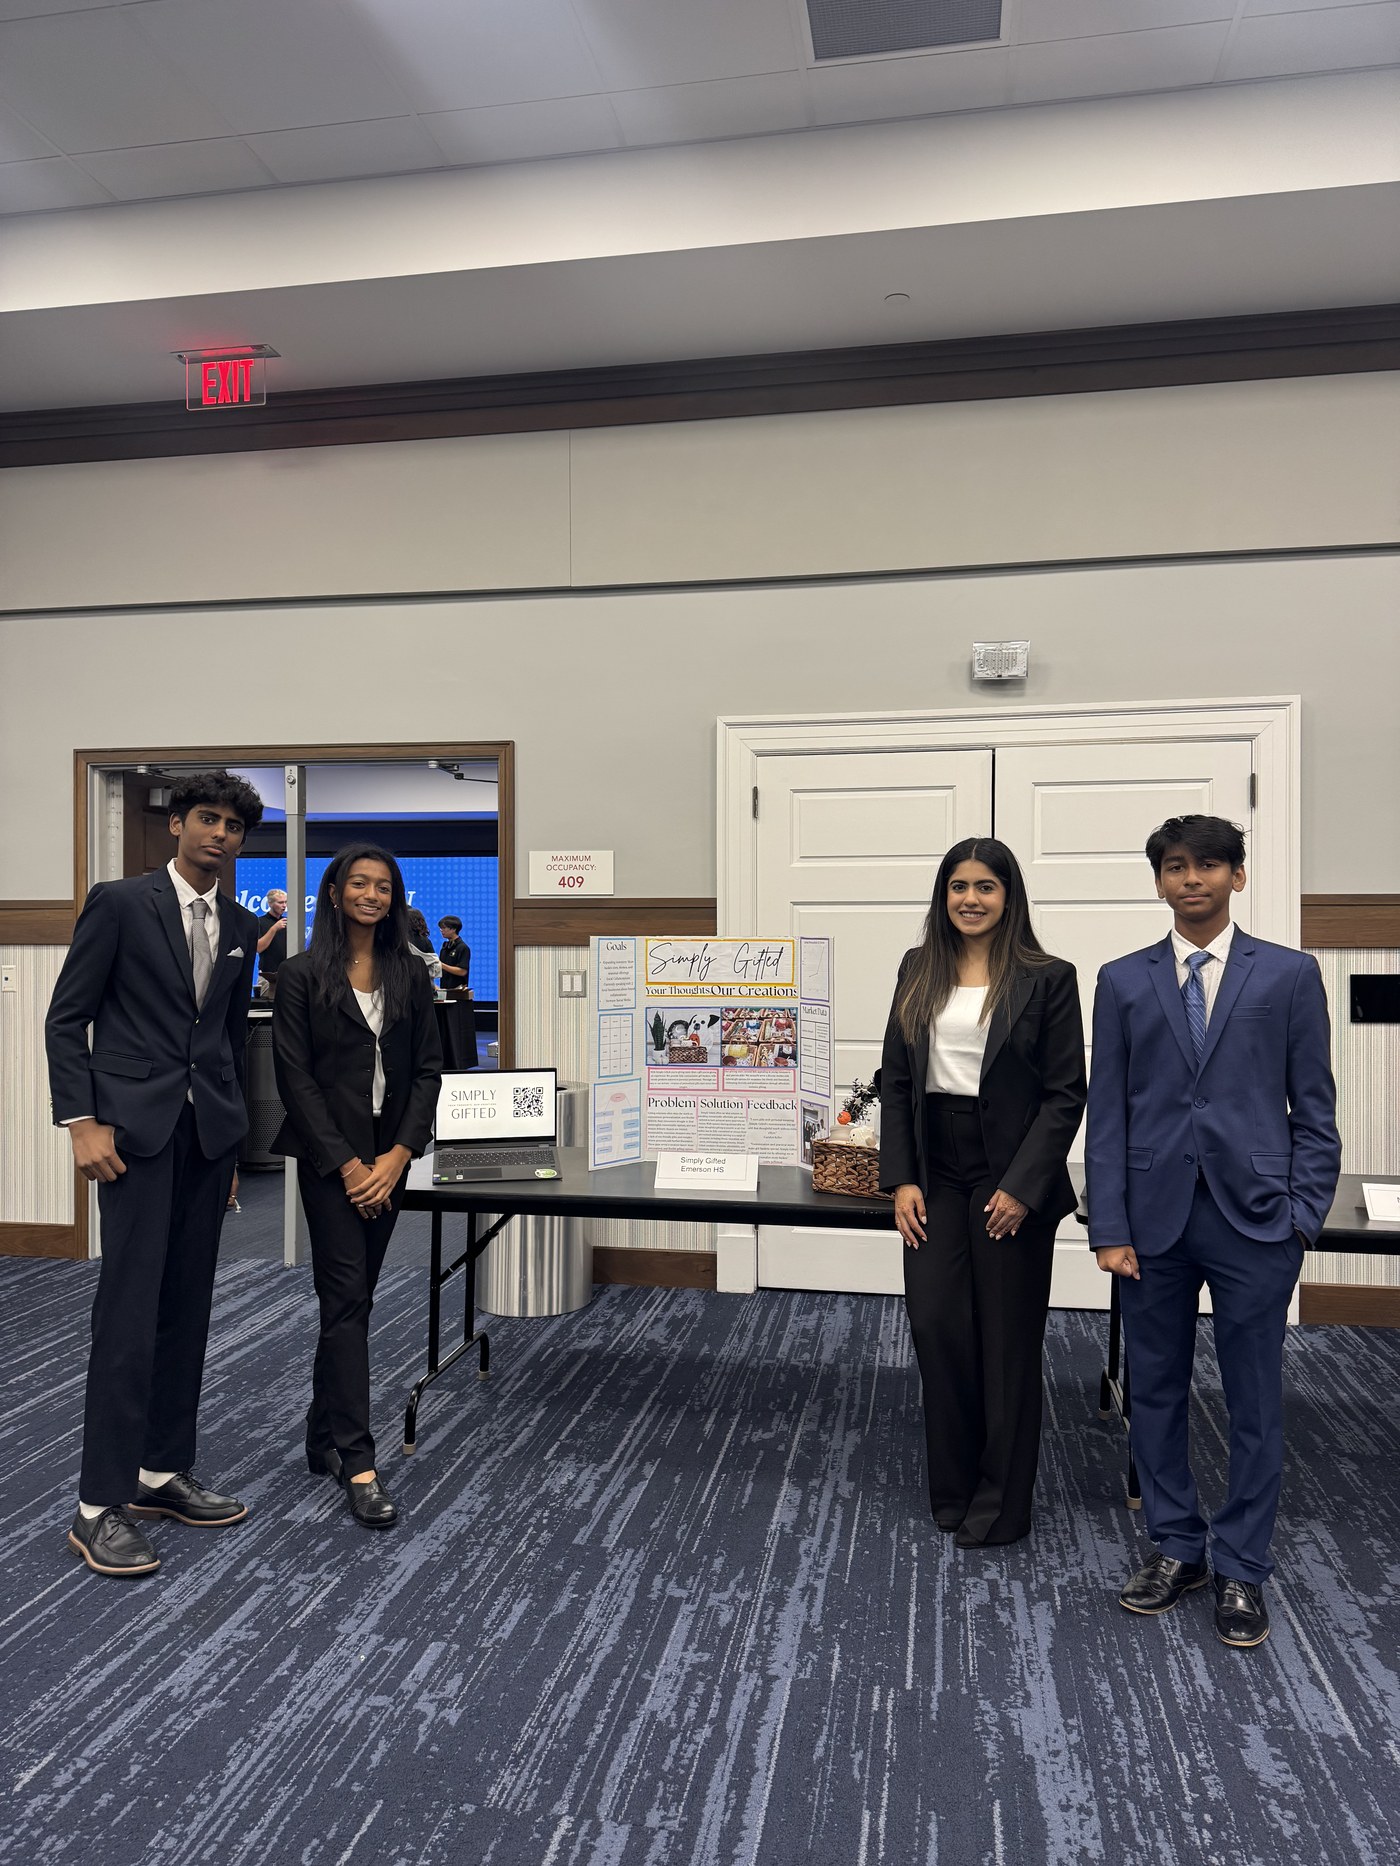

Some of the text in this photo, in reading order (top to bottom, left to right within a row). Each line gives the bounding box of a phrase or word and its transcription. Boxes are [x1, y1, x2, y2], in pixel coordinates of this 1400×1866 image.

[202, 359, 254, 405] EXIT
[558, 876, 585, 888] 409
[606, 941, 627, 951] Goals
[649, 942, 784, 981] Simply Gifted
[646, 986, 667, 995] Your
[711, 985, 735, 996] Our
[451, 1089, 497, 1101] SIMPLY
[648, 1097, 696, 1108] Problem
[700, 1098, 743, 1109] Solution
[747, 1099, 797, 1110] Feedback
[451, 1107, 497, 1119] GIFTED
[680, 1157, 703, 1165] Simply
[681, 1165, 712, 1173] Emerson
